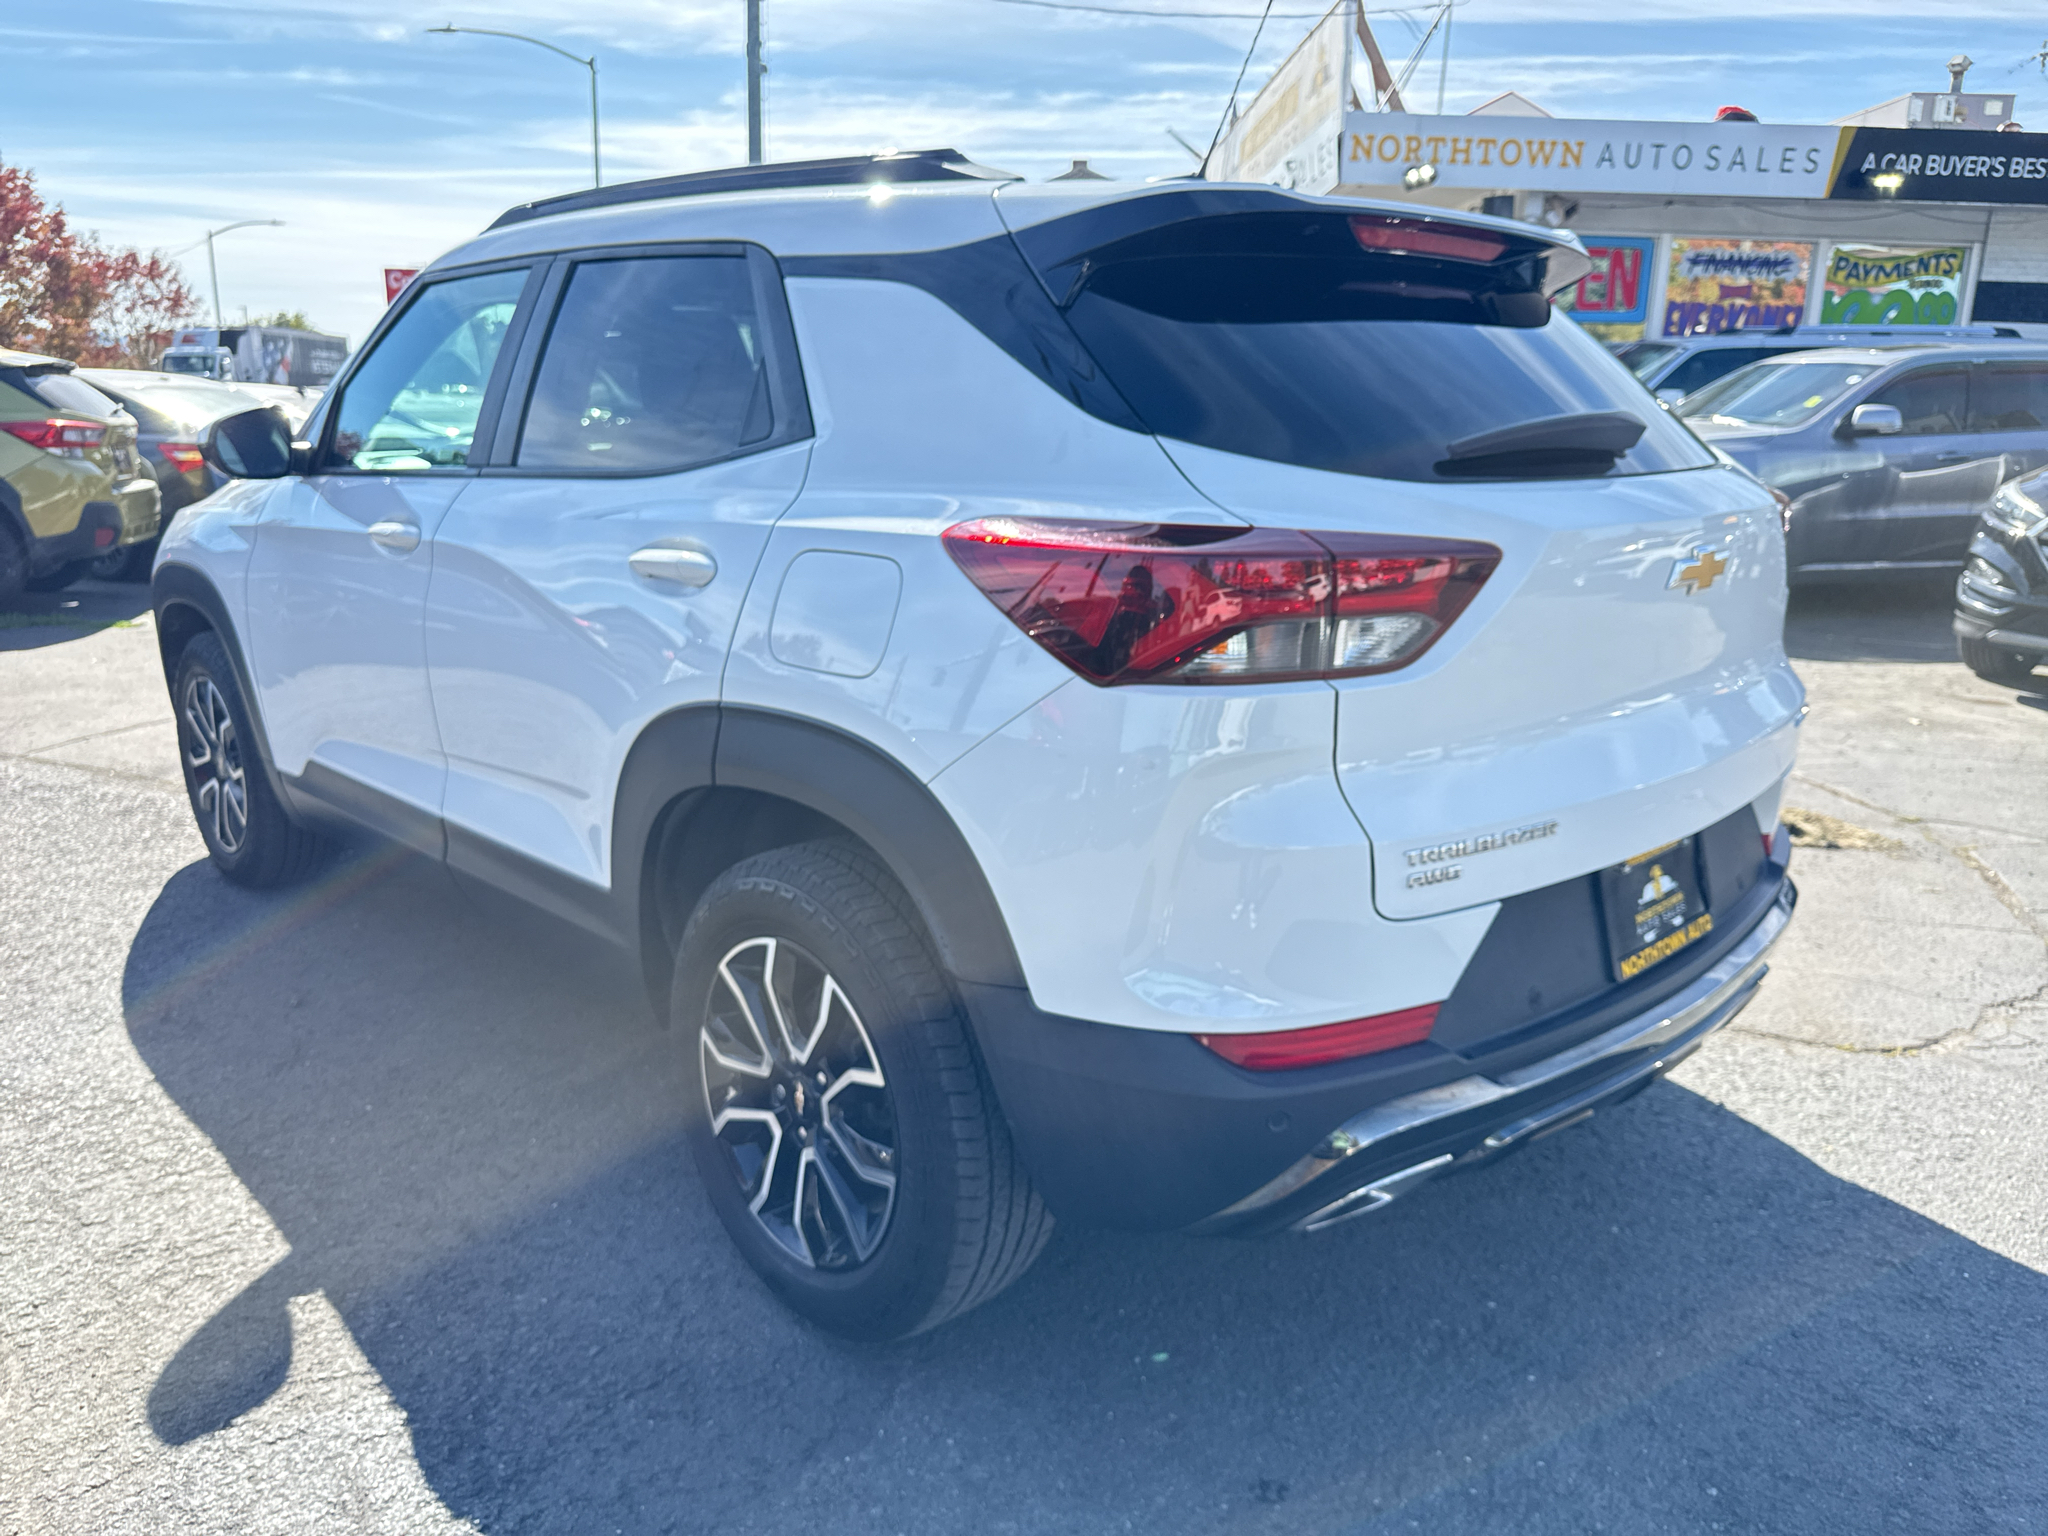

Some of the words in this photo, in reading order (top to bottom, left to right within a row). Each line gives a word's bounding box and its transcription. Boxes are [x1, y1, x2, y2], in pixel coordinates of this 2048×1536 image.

[1350, 133, 1585, 168] NORTHTOWN
[1596, 141, 1693, 170] AUTO
[1704, 145, 1821, 174] SALES
[1860, 152, 1876, 173] A
[1880, 152, 1923, 175] CAR
[1924, 154, 2007, 178] BUYER'S
[2008, 157, 2048, 179] BES
[1576, 247, 1641, 311] EN
[1833, 253, 1957, 282] PAYMENTS
[1403, 818, 1559, 866] TRAILBLAZER
[1406, 864, 1462, 889] AWD
[1620, 928, 1687, 979] NORTHTOWN
[1687, 913, 1713, 940] AUTO
